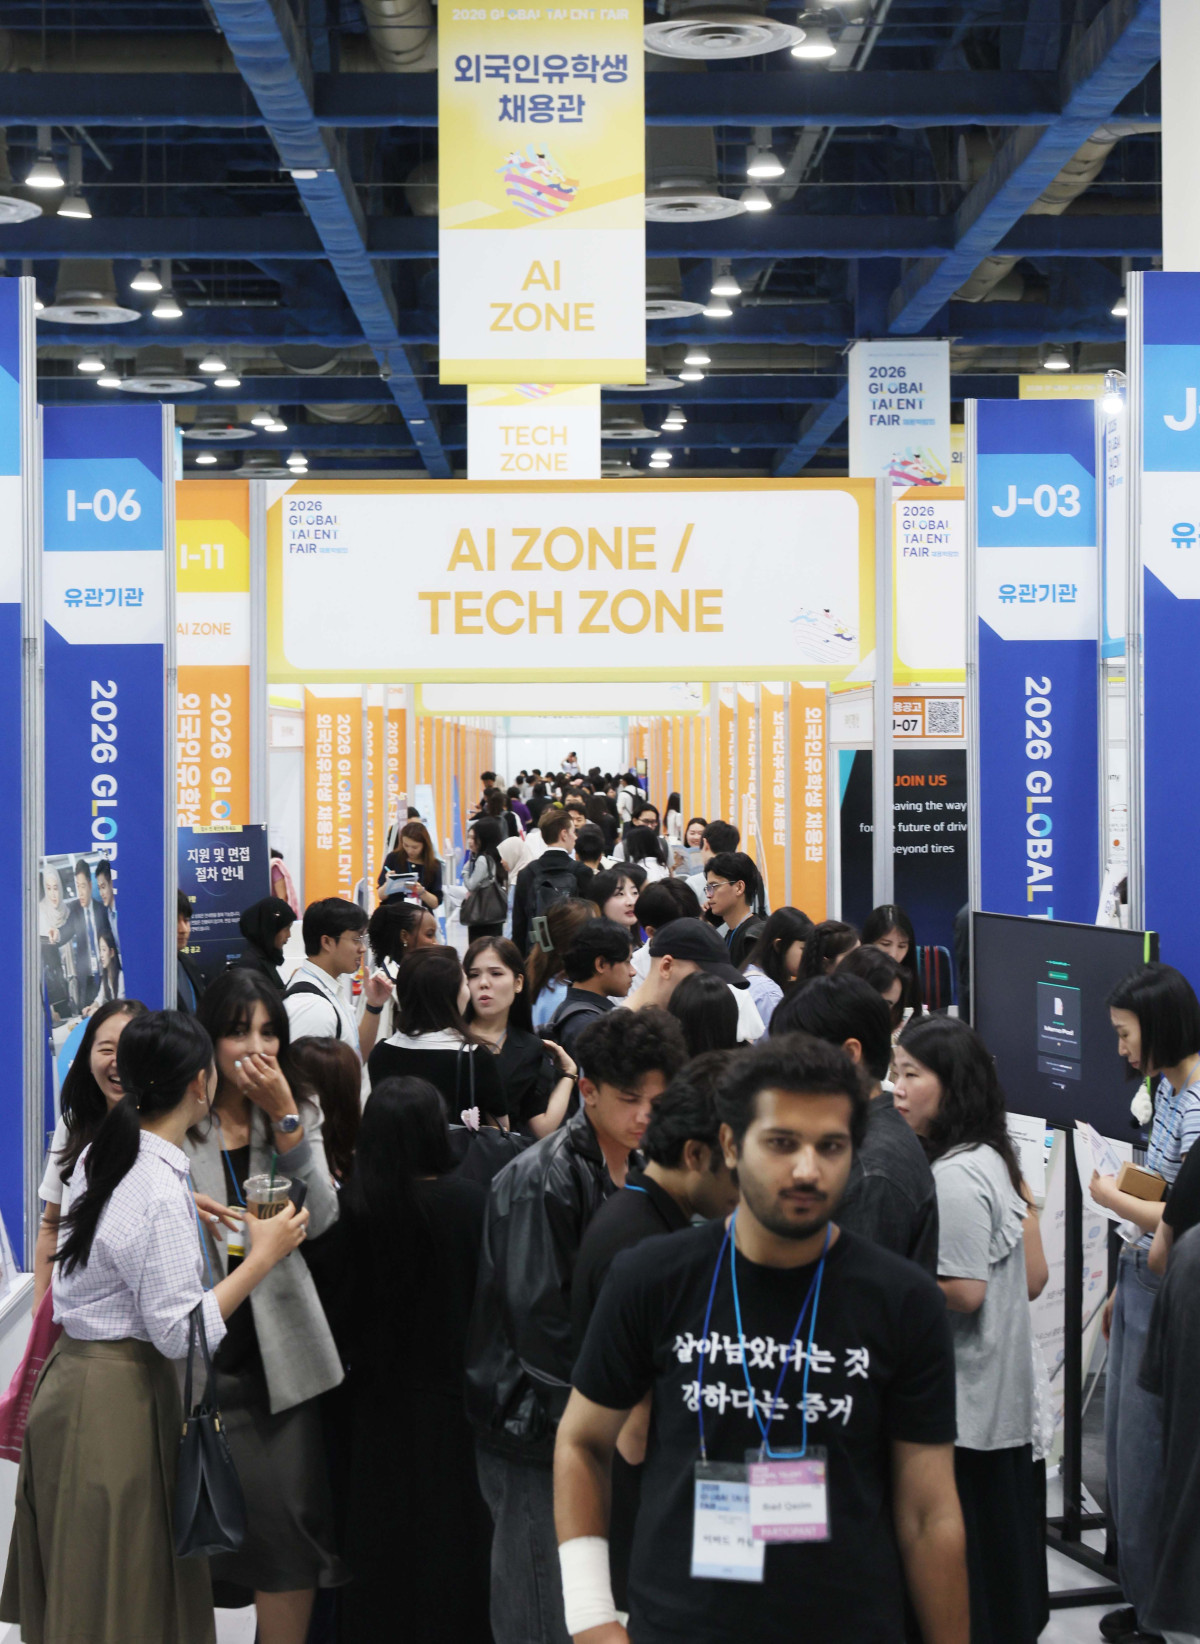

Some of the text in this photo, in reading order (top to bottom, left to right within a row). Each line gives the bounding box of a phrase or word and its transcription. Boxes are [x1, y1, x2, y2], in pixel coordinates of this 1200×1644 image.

[452, 8, 629, 20] 2026 GLOBAL TALENT FAIR
[454, 54, 628, 84] 외국인유학생
[498, 94, 586, 124] 채용관
[520, 260, 560, 291] AI
[489, 302, 595, 332] ZONE
[868, 366, 907, 379] 2026
[868, 382, 926, 395] GLOBAL
[869, 397, 925, 410] TALENT
[1163, 387, 1200, 432] J
[869, 414, 900, 426] FAIR
[499, 425, 568, 446] TECH
[499, 453, 568, 472] ZONE
[951, 451, 964, 464] 외
[66, 488, 142, 522] I-06
[289, 500, 323, 511] 2026
[903, 506, 934, 516] 2026
[991, 484, 1081, 518] J-03
[289, 514, 340, 526] GLOBAL
[902, 520, 951, 530] GLOBAL
[291, 529, 339, 540] TALENT
[903, 533, 951, 544] TALENT
[1170, 522, 1200, 549] 유
[180, 543, 225, 570] I-11
[289, 543, 317, 554] FAIR
[446, 523, 696, 573] AI ZONE /
[903, 547, 930, 557] FAIR
[64, 587, 144, 608] 유관기관
[997, 584, 1078, 604] 유관기관
[418, 588, 724, 636] TECH ZONE
[176, 622, 232, 636] AI ZONE
[893, 702, 922, 713] 용공고
[210, 693, 232, 759] 2026
[1025, 676, 1052, 760] 2026
[337, 713, 351, 755] 2026
[91, 679, 118, 896] 2026 GLOB
[316, 713, 334, 850] 외국인유학생 채용관
[337, 758, 352, 823] GLOBAL
[804, 707, 824, 863] 외국인유학생 채용관
[894, 775, 948, 787] JOIN US
[893, 800, 967, 812] aving the way
[898, 823, 931, 832] future
[933, 822, 945, 831] of
[947, 821, 967, 831] driv
[1026, 770, 1053, 902] GLOBAL
[187, 846, 250, 864] 지원 및 면접
[337, 824, 352, 886] TALENT
[893, 843, 955, 855] eyond tires
[195, 865, 244, 883] 절차 안내
[672, 1331, 870, 1379] 살아남았다는 것
[681, 1380, 853, 1426] 강하다는 증거
